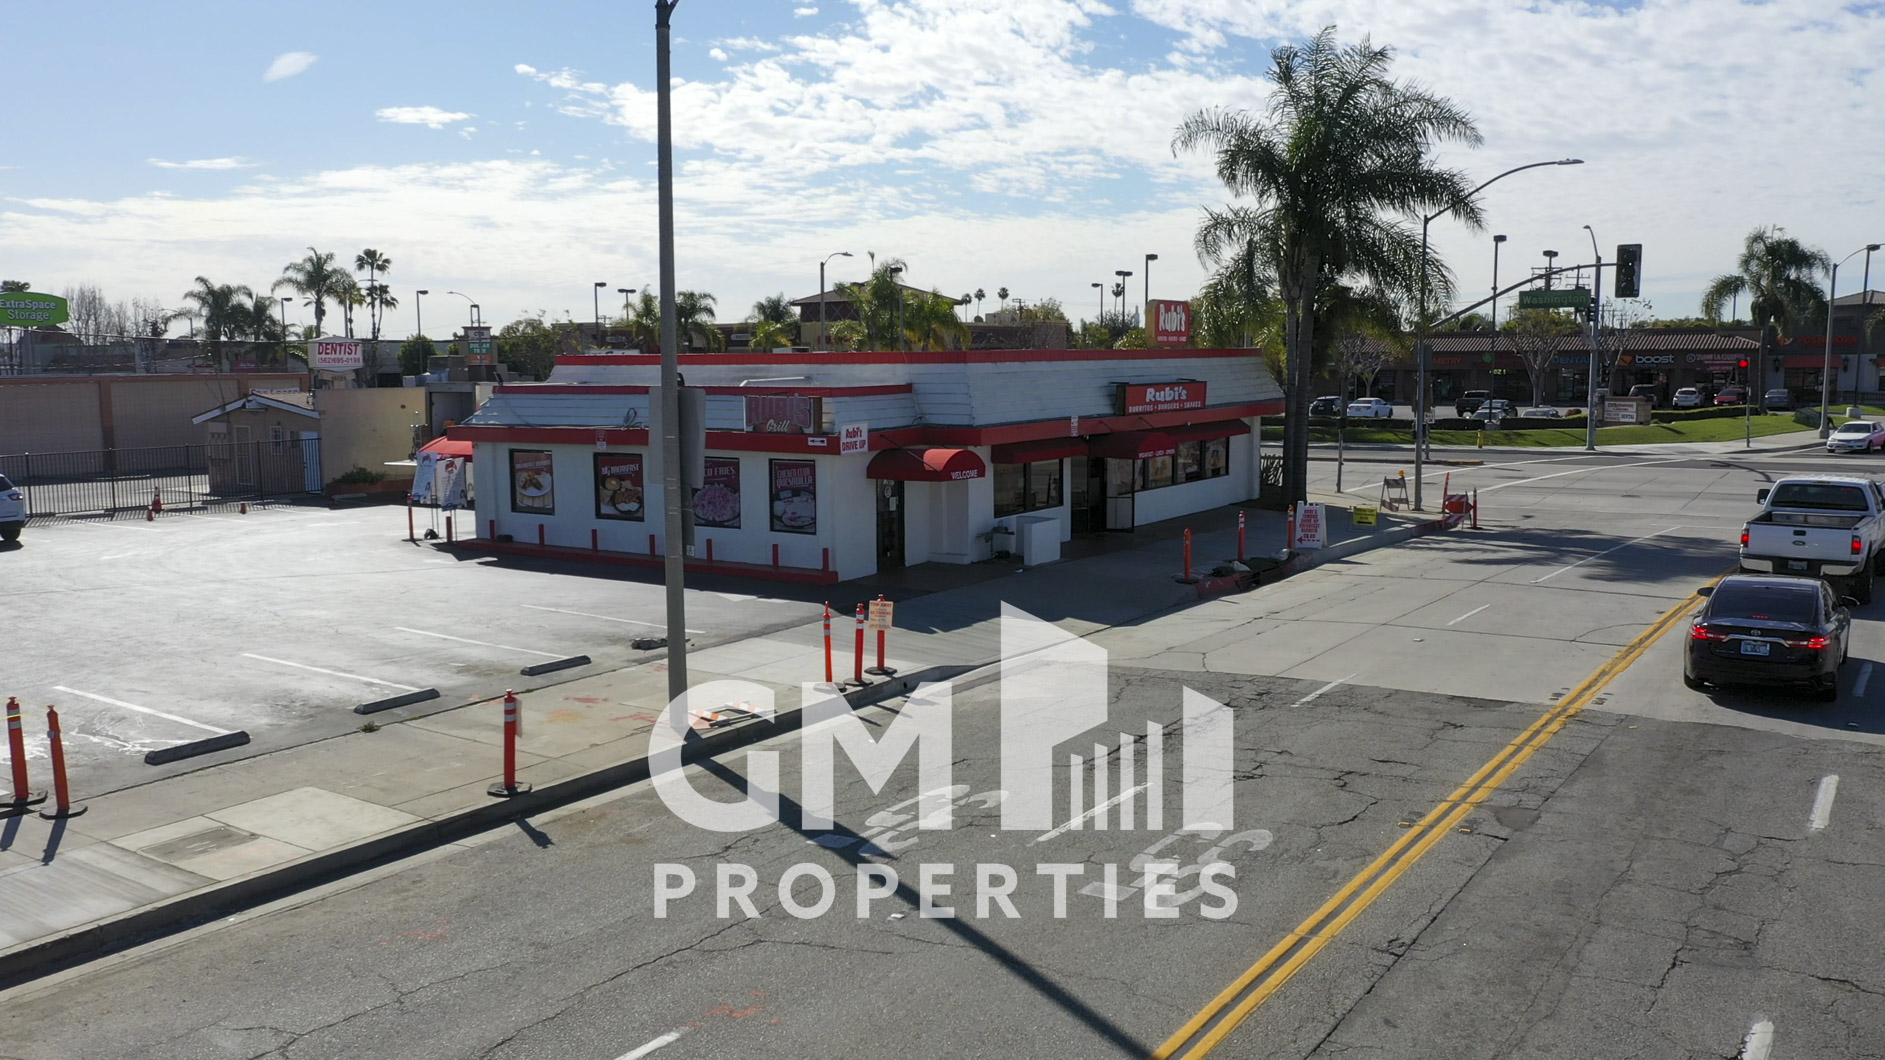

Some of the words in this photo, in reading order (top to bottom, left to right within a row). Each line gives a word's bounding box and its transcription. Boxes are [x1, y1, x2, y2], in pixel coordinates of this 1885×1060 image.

[0, 299, 57, 310] ExtraSpace
[1522, 295, 1586, 305] Washington
[7, 309, 50, 322] Storage
[1159, 303, 1186, 332] Rubi's
[317, 342, 360, 355] DENTIST
[1635, 354, 1675, 363] boost
[1145, 386, 1187, 403] Rubi's
[747, 394, 811, 428] RUBI'S
[1128, 404, 1154, 413] BURRITOS
[1157, 402, 1180, 410] BURGERS
[766, 418, 790, 432] Grill
[842, 441, 858, 451] DRIVE
[859, 439, 866, 449] UP
[714, 466, 735, 476] FRIES
[950, 469, 978, 480] WELCOME
